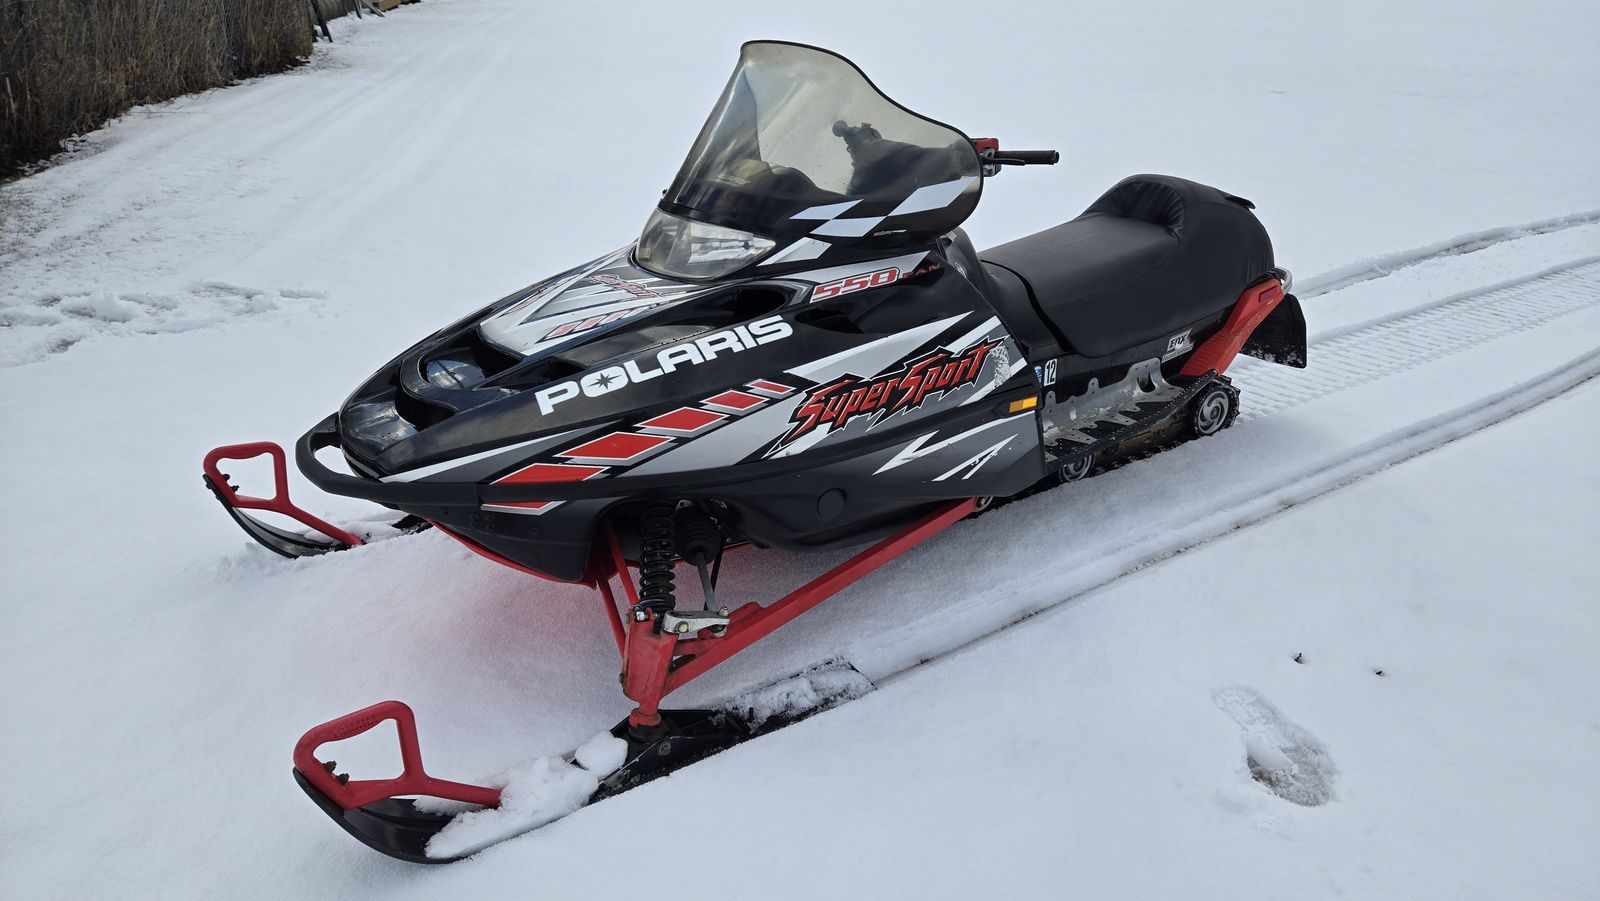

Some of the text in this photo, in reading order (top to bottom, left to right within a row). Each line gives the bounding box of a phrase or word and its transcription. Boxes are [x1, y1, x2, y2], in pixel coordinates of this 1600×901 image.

[811, 267, 898, 303] 550
[534, 315, 794, 416] POLARIS
[1046, 360, 1056, 384] 12
